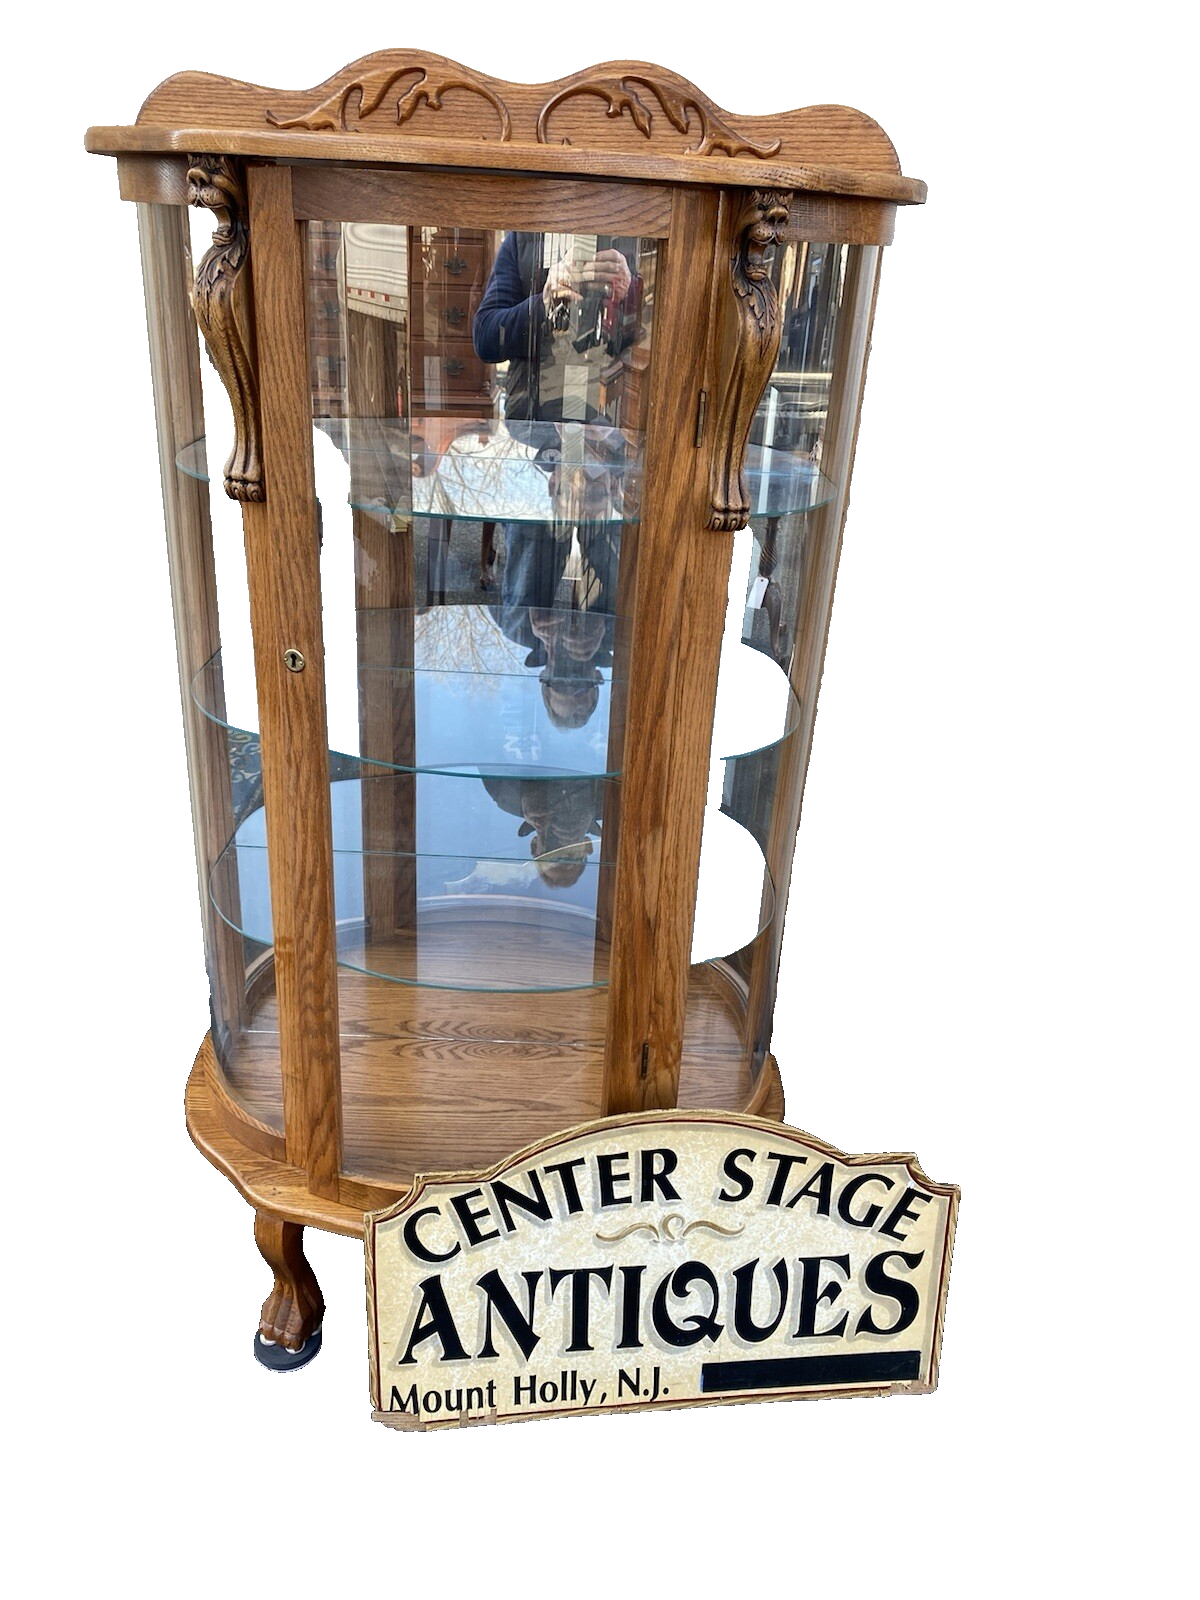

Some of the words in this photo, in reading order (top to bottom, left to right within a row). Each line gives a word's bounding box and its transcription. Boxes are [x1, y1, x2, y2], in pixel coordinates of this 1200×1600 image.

[403, 1148, 682, 1262] CENTER
[719, 1148, 934, 1241] STAGE
[398, 1250, 926, 1364] ANTIQUES
[389, 1380, 497, 1415] Mount
[514, 1370, 608, 1406] Holly,
[618, 1366, 670, 1402] N.J.
